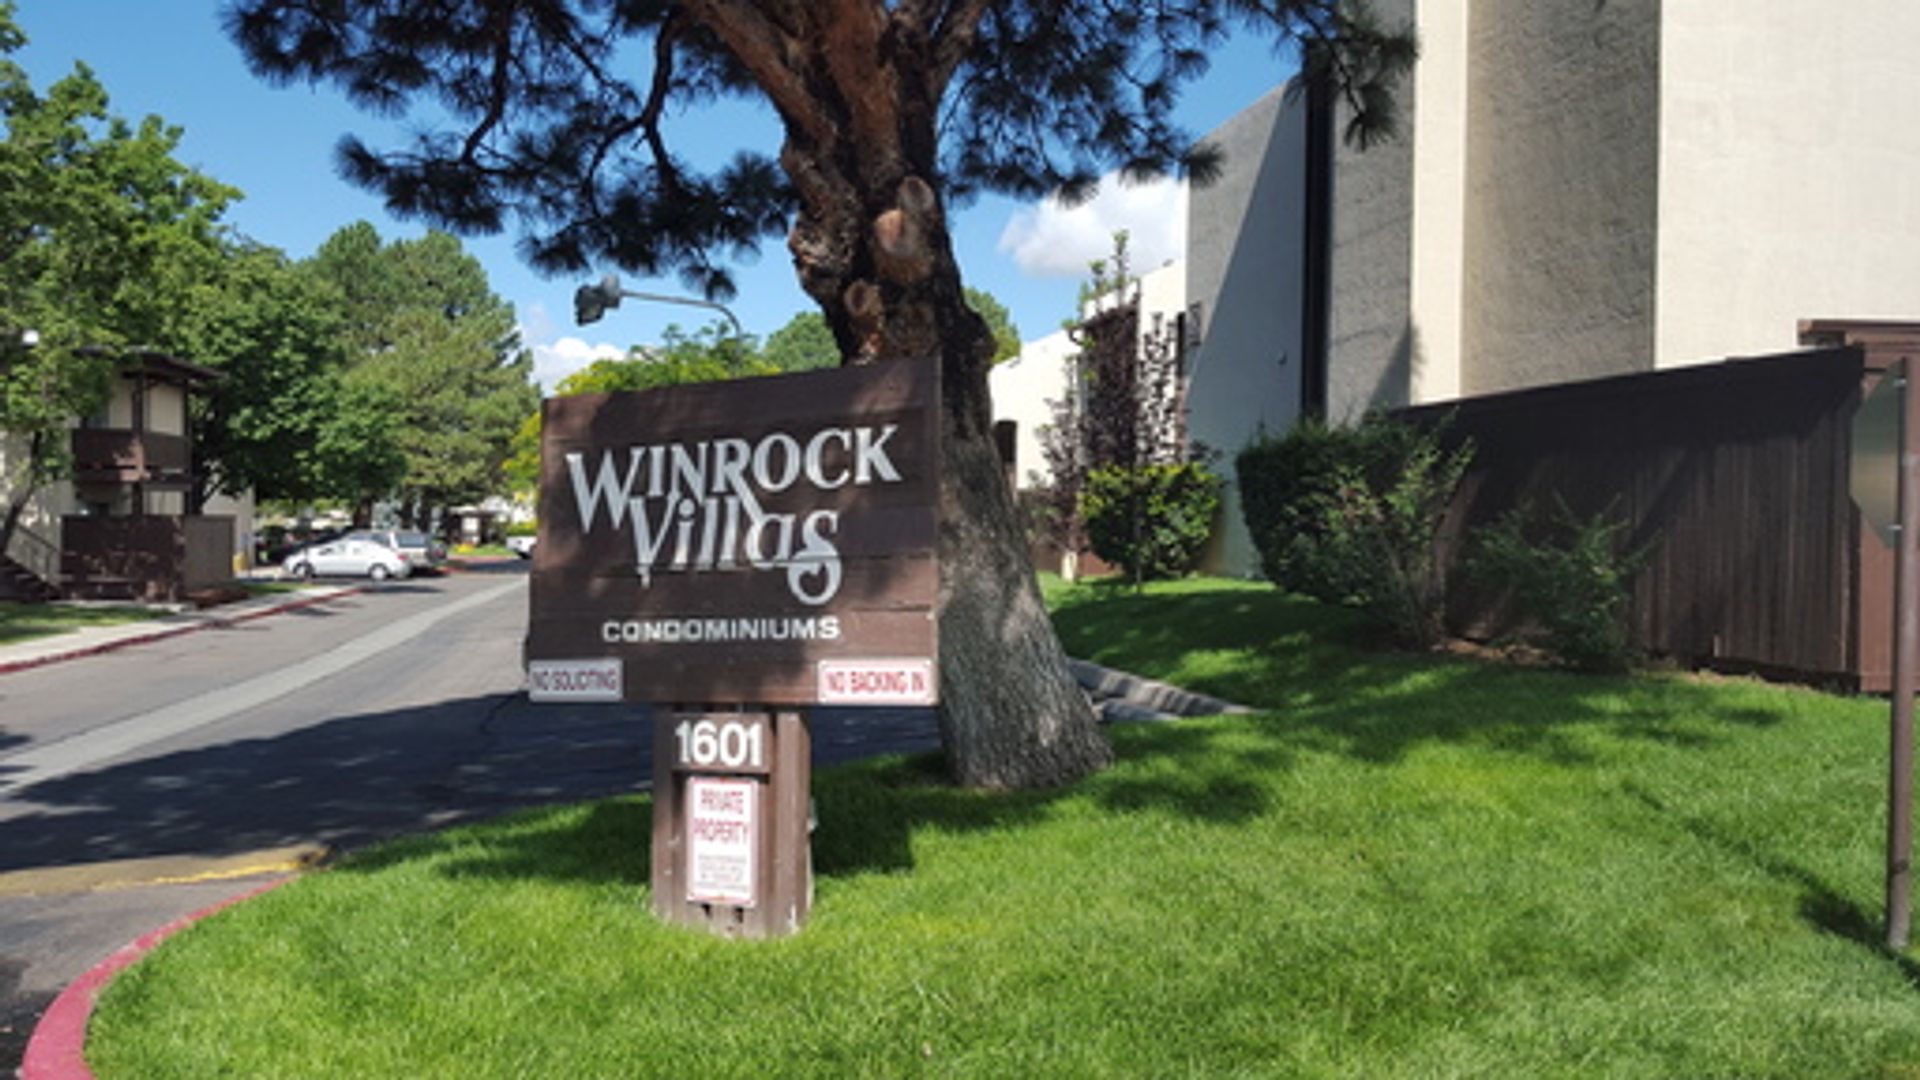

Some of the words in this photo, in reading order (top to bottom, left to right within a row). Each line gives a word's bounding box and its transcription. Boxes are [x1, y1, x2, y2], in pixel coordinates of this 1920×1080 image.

[566, 424, 902, 533] WINROCK
[628, 495, 842, 605] Villas
[603, 615, 841, 642] CONDOMINIUMS
[533, 670, 549, 690] NO
[552, 669, 617, 691] SOLICITING
[826, 672, 845, 693] NO
[850, 672, 905, 693] BACKING
[911, 672, 925, 691] IN
[675, 719, 763, 767] 1601
